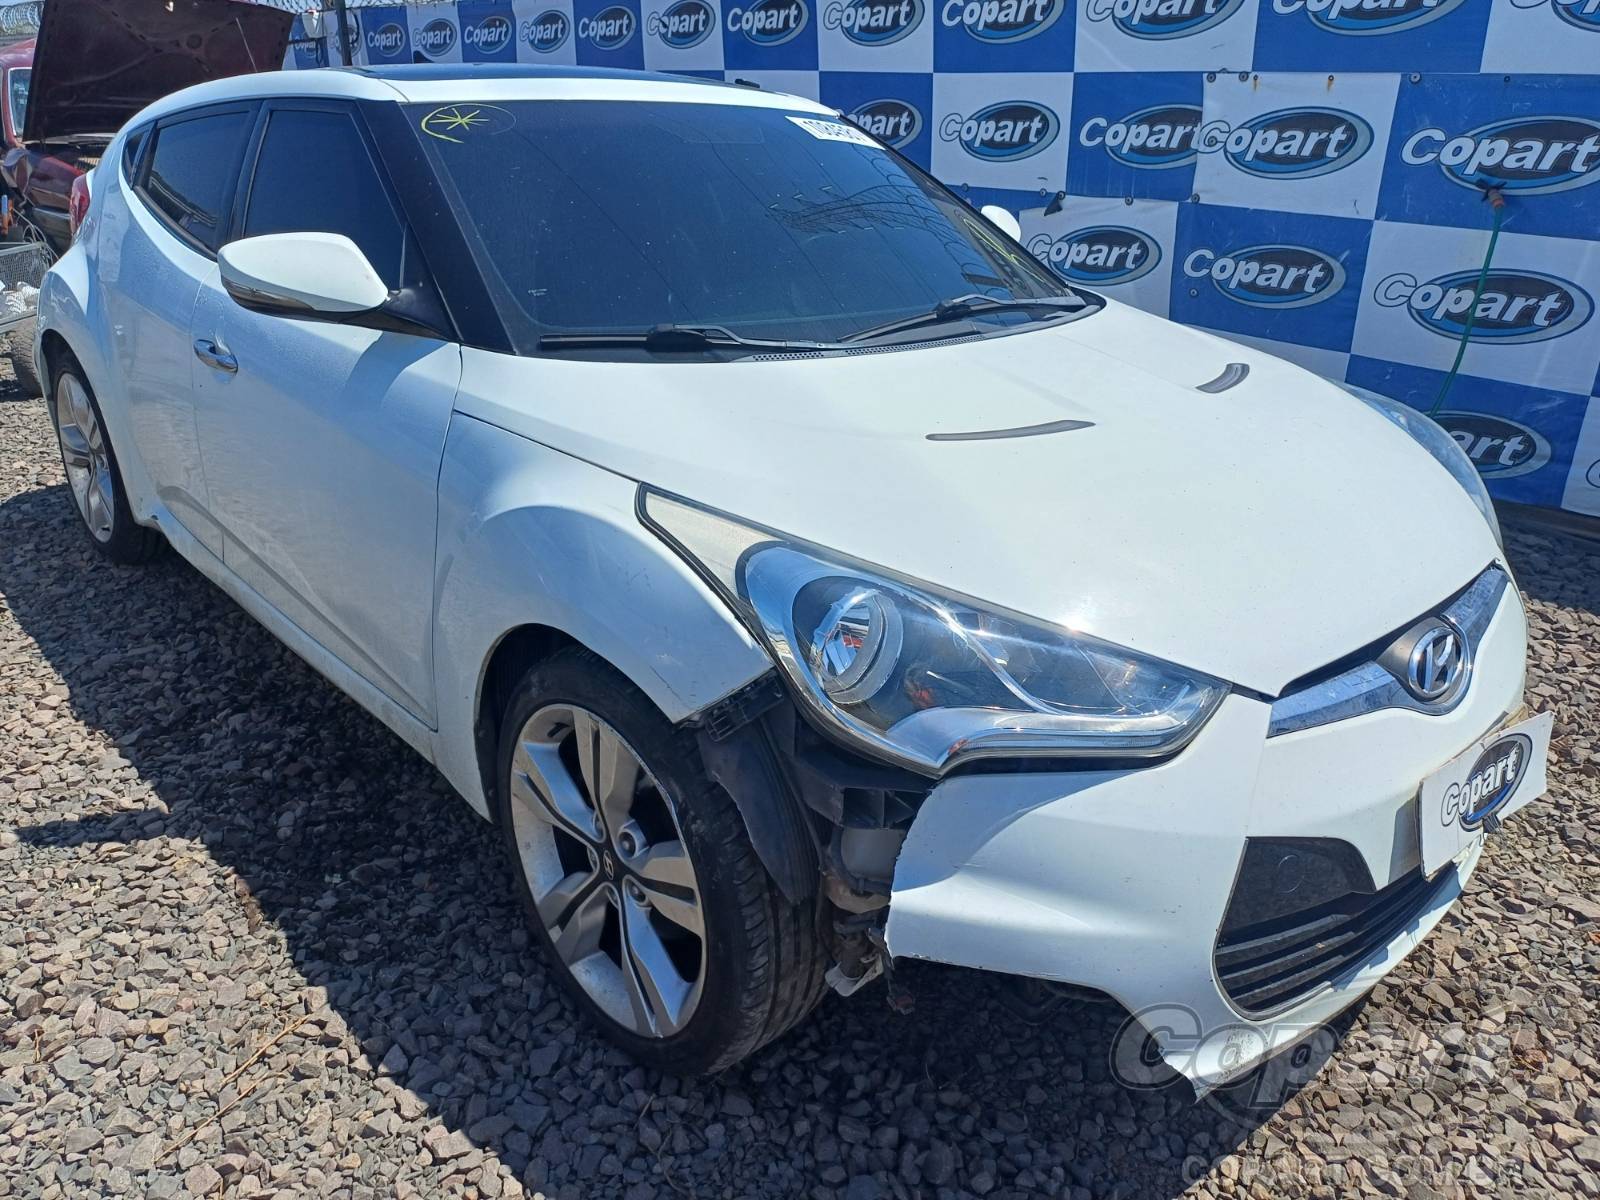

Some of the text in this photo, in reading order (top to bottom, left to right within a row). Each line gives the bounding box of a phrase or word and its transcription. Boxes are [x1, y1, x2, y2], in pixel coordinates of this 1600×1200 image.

[519, 19, 564, 46] Copart
[578, 15, 629, 40] Copart
[647, 8, 706, 38] Copart
[727, 2, 798, 36] Copart
[824, 0, 911, 34] Copart
[942, 0, 1048, 31] Copart
[367, 30, 401, 50] Copart
[413, 26, 451, 48] Copart
[464, 23, 507, 47] Copart
[839, 109, 909, 138] part
[939, 113, 1042, 147] Copart
[1199, 120, 1349, 162] Copart
[1401, 128, 1600, 177] Copart
[1026, 233, 1142, 270] Copart
[1183, 248, 1328, 294] Copart
[1374, 272, 1563, 328] Copart
[1447, 430, 1525, 466] art
[1441, 741, 1521, 827] Copart
